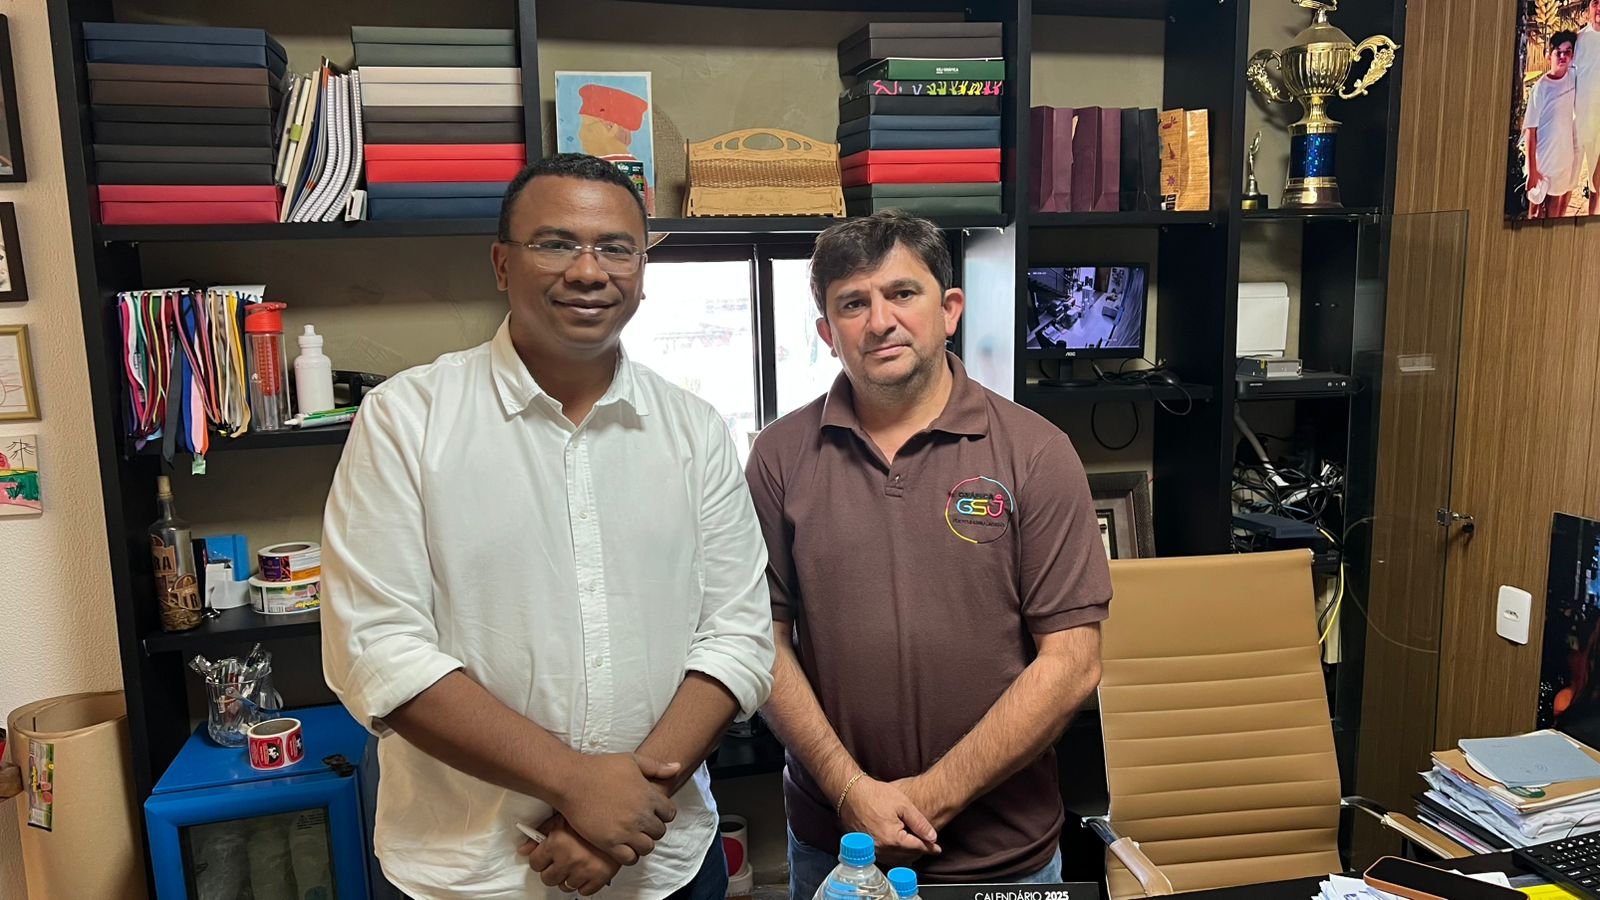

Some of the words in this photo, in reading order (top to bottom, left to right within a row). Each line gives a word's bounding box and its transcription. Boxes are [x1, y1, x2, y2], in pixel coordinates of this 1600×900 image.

[956, 496, 1004, 518] GSJ
[974, 889, 1042, 900] CALENDÁRIO
[1044, 890, 1069, 900] 2025
